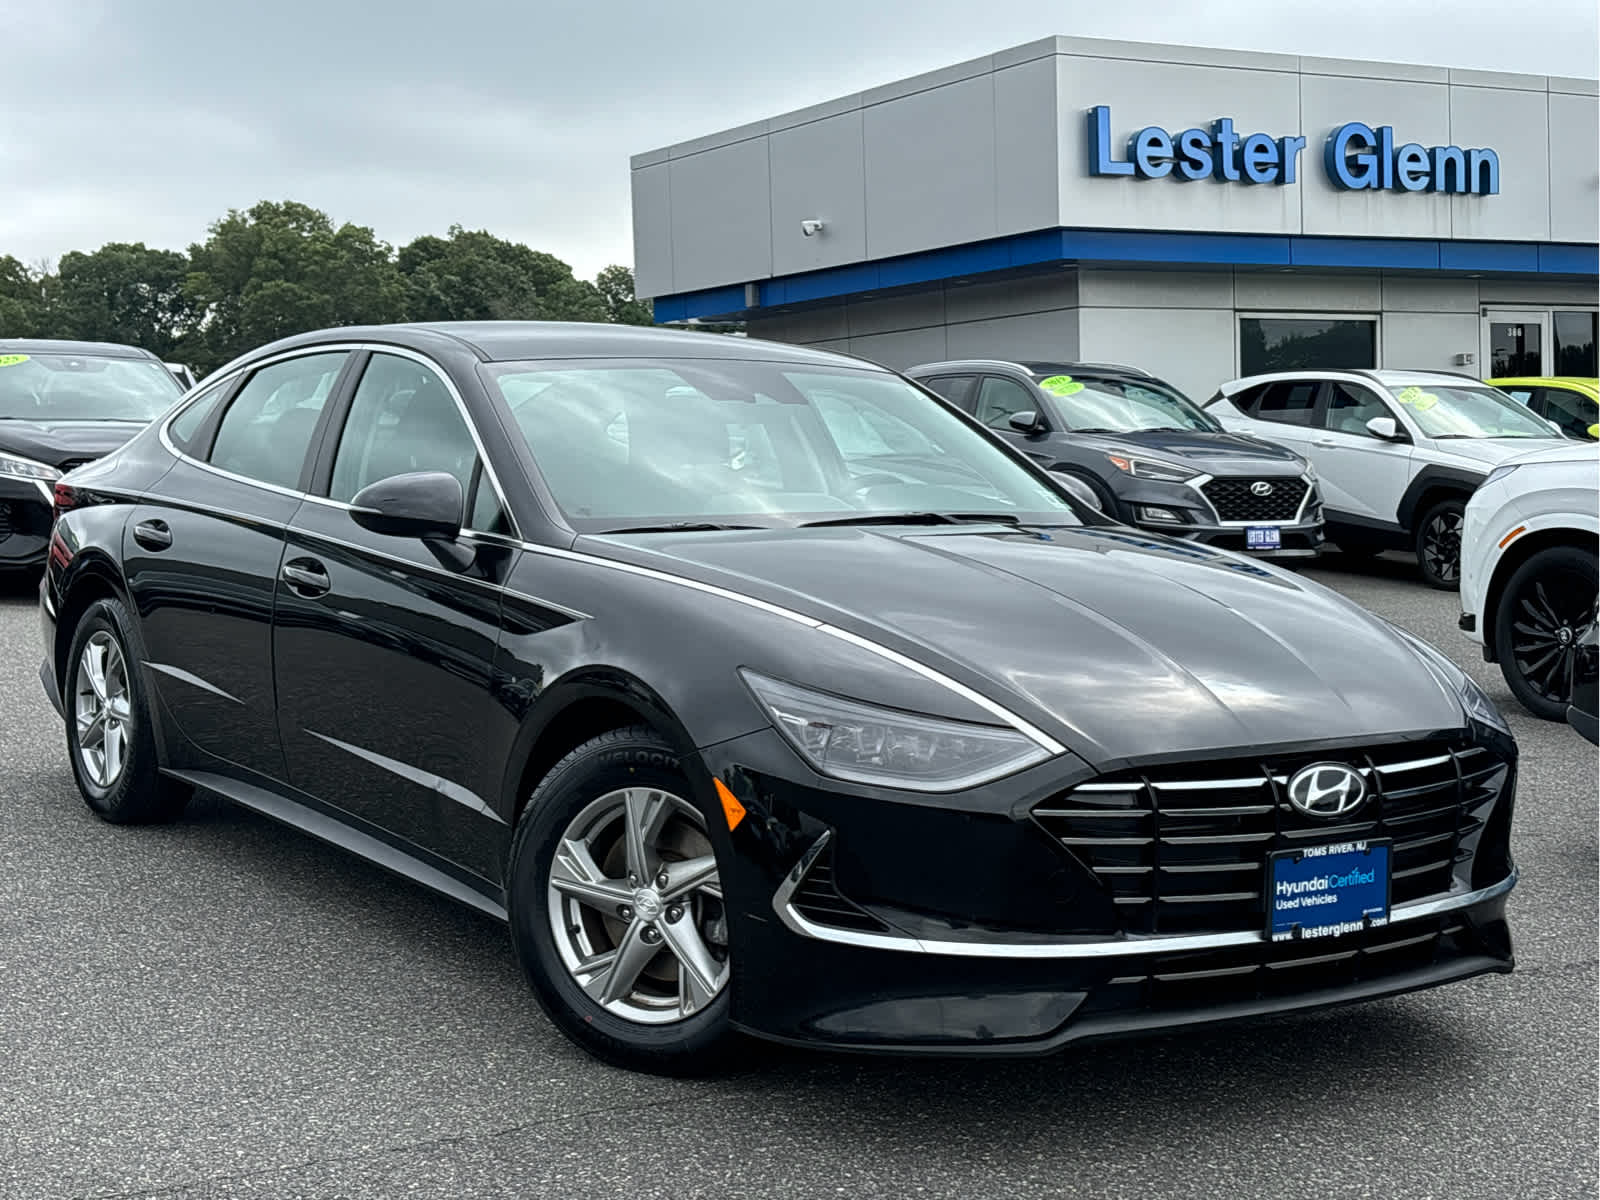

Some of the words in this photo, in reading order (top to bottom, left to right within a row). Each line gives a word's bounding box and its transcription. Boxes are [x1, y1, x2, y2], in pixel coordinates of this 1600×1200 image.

[1088, 105, 1306, 184] Lester
[1326, 121, 1500, 195] Glenn
[1303, 847, 1328, 858] TOMS
[1356, 841, 1368, 851] NJ
[1276, 898, 1299, 910] Used
[1300, 894, 1338, 907] Vehicles
[1302, 921, 1363, 939] lesterglenn
